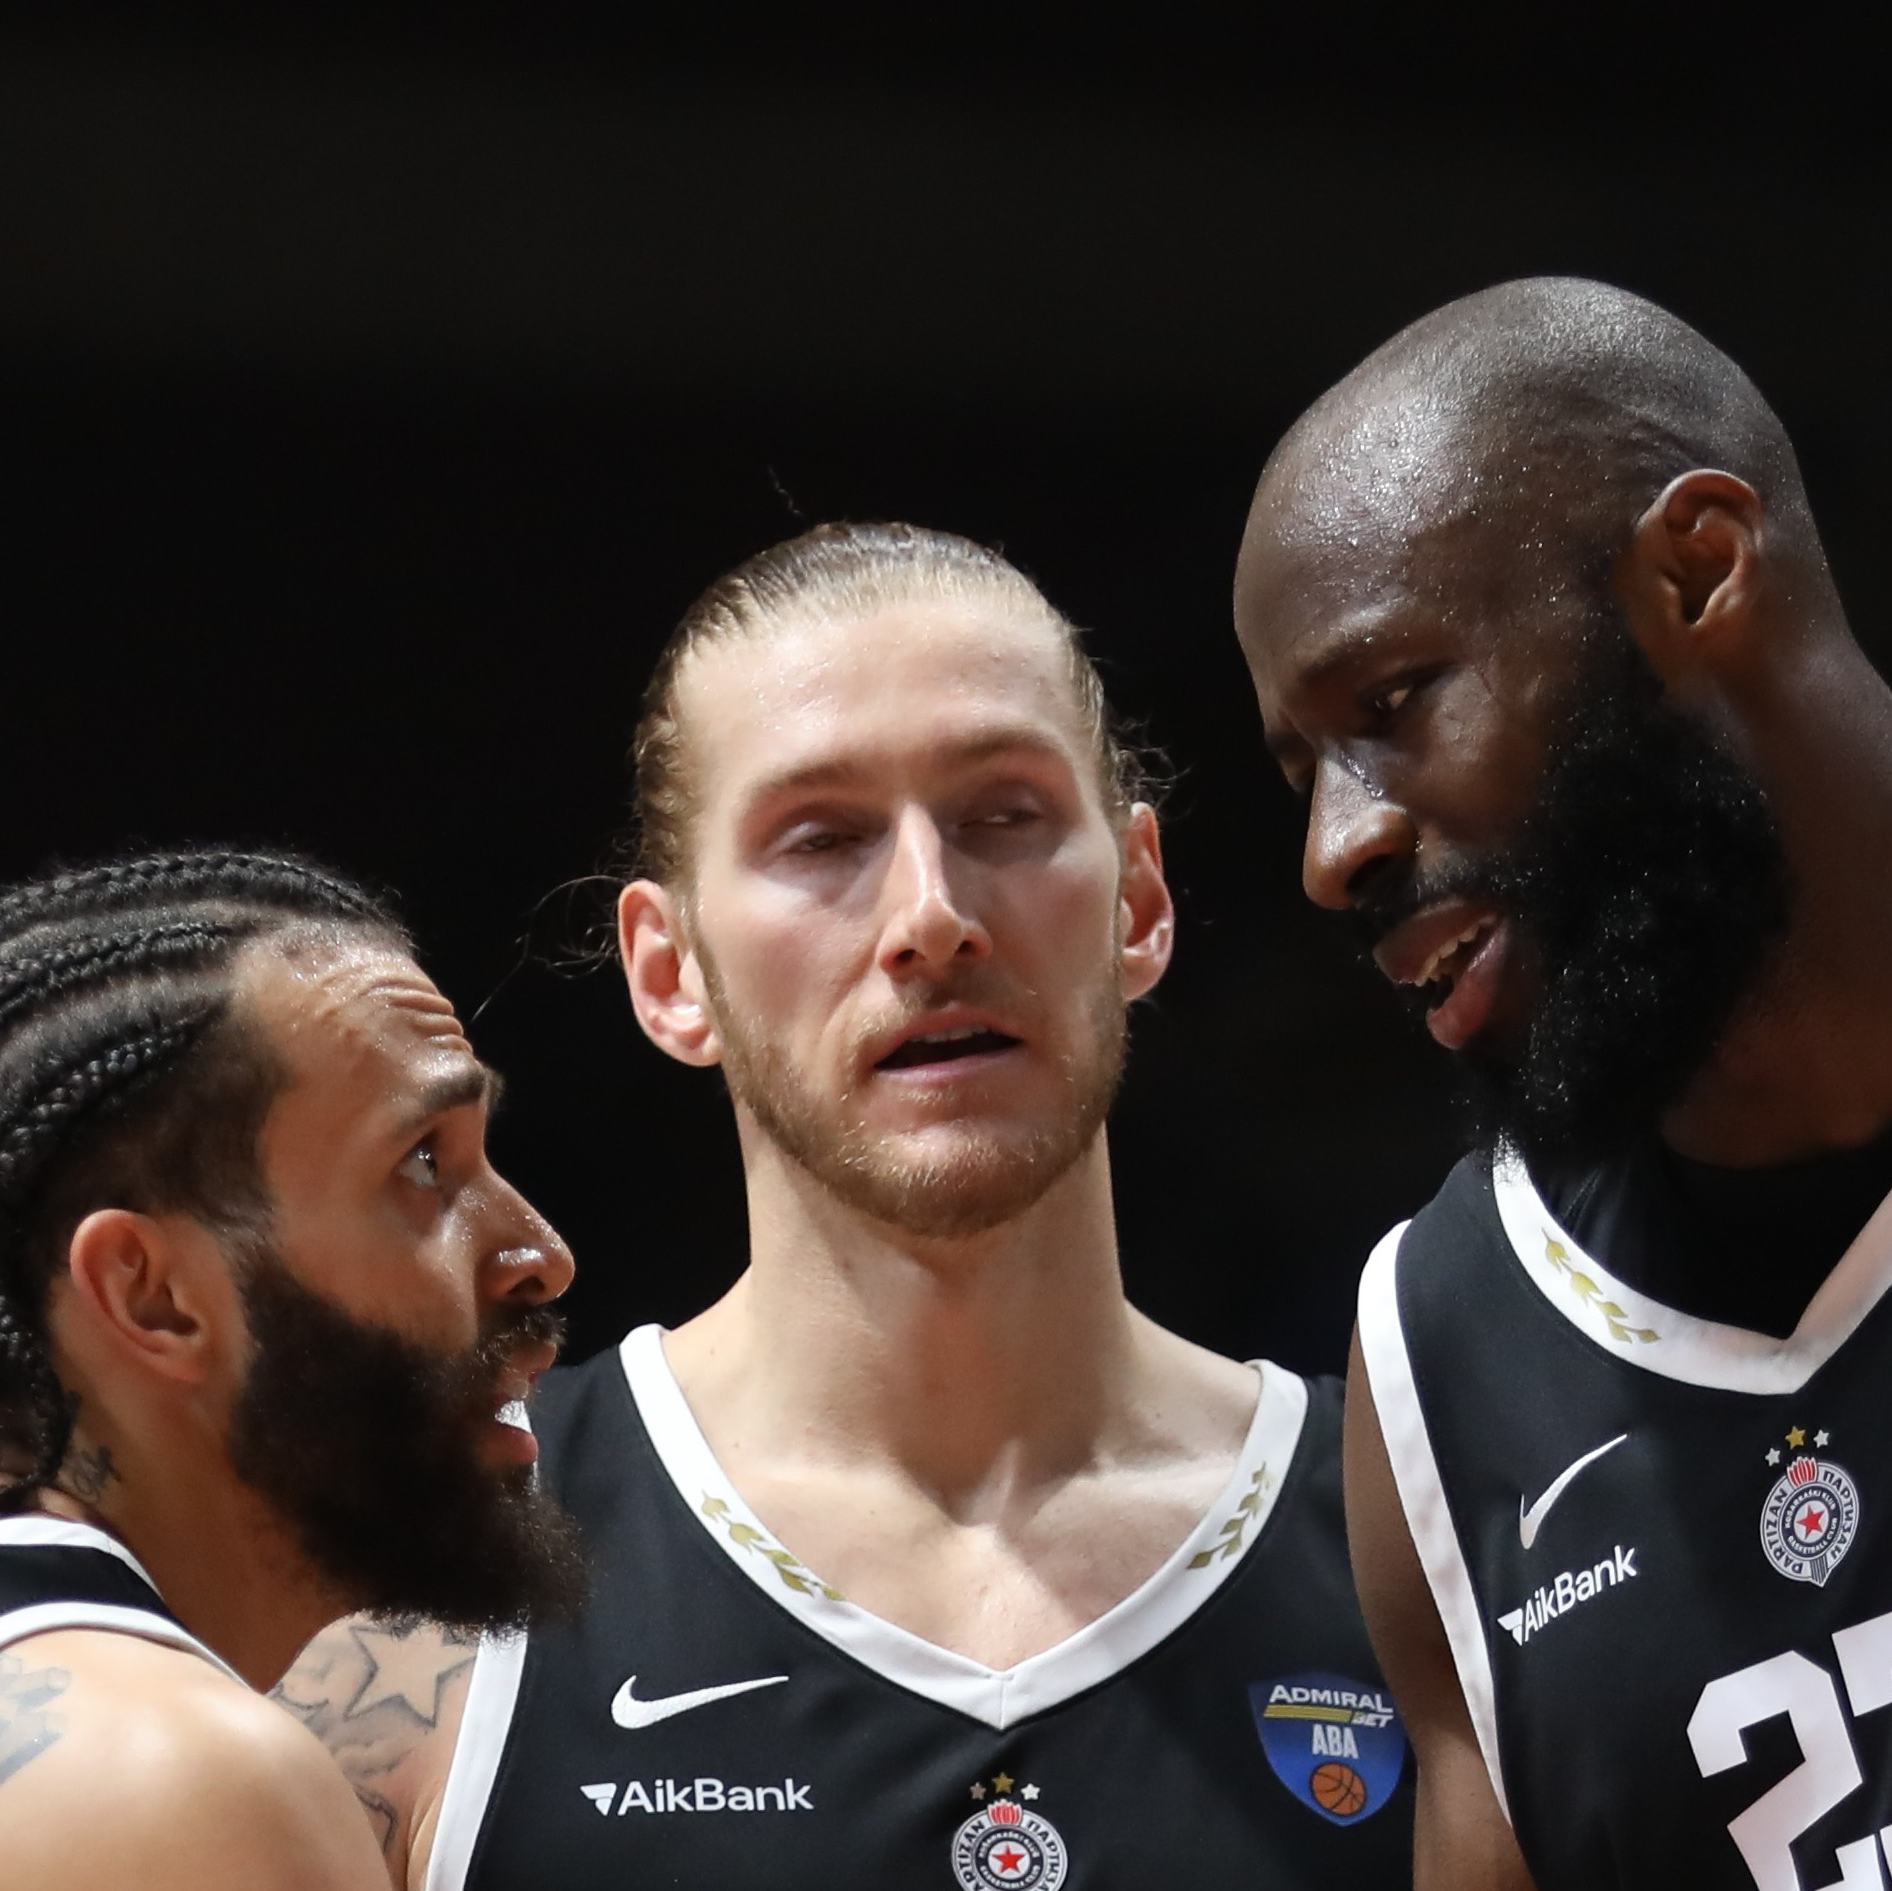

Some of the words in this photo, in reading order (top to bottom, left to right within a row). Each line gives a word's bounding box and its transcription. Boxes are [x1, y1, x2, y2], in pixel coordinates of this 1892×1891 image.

[1524, 1544, 1638, 1643] AikBank
[1269, 1684, 1394, 1713] ADMIRAL
[1351, 1710, 1394, 1728] BET
[1312, 1723, 1359, 1759] ABA
[617, 1778, 814, 1816] AikBank
